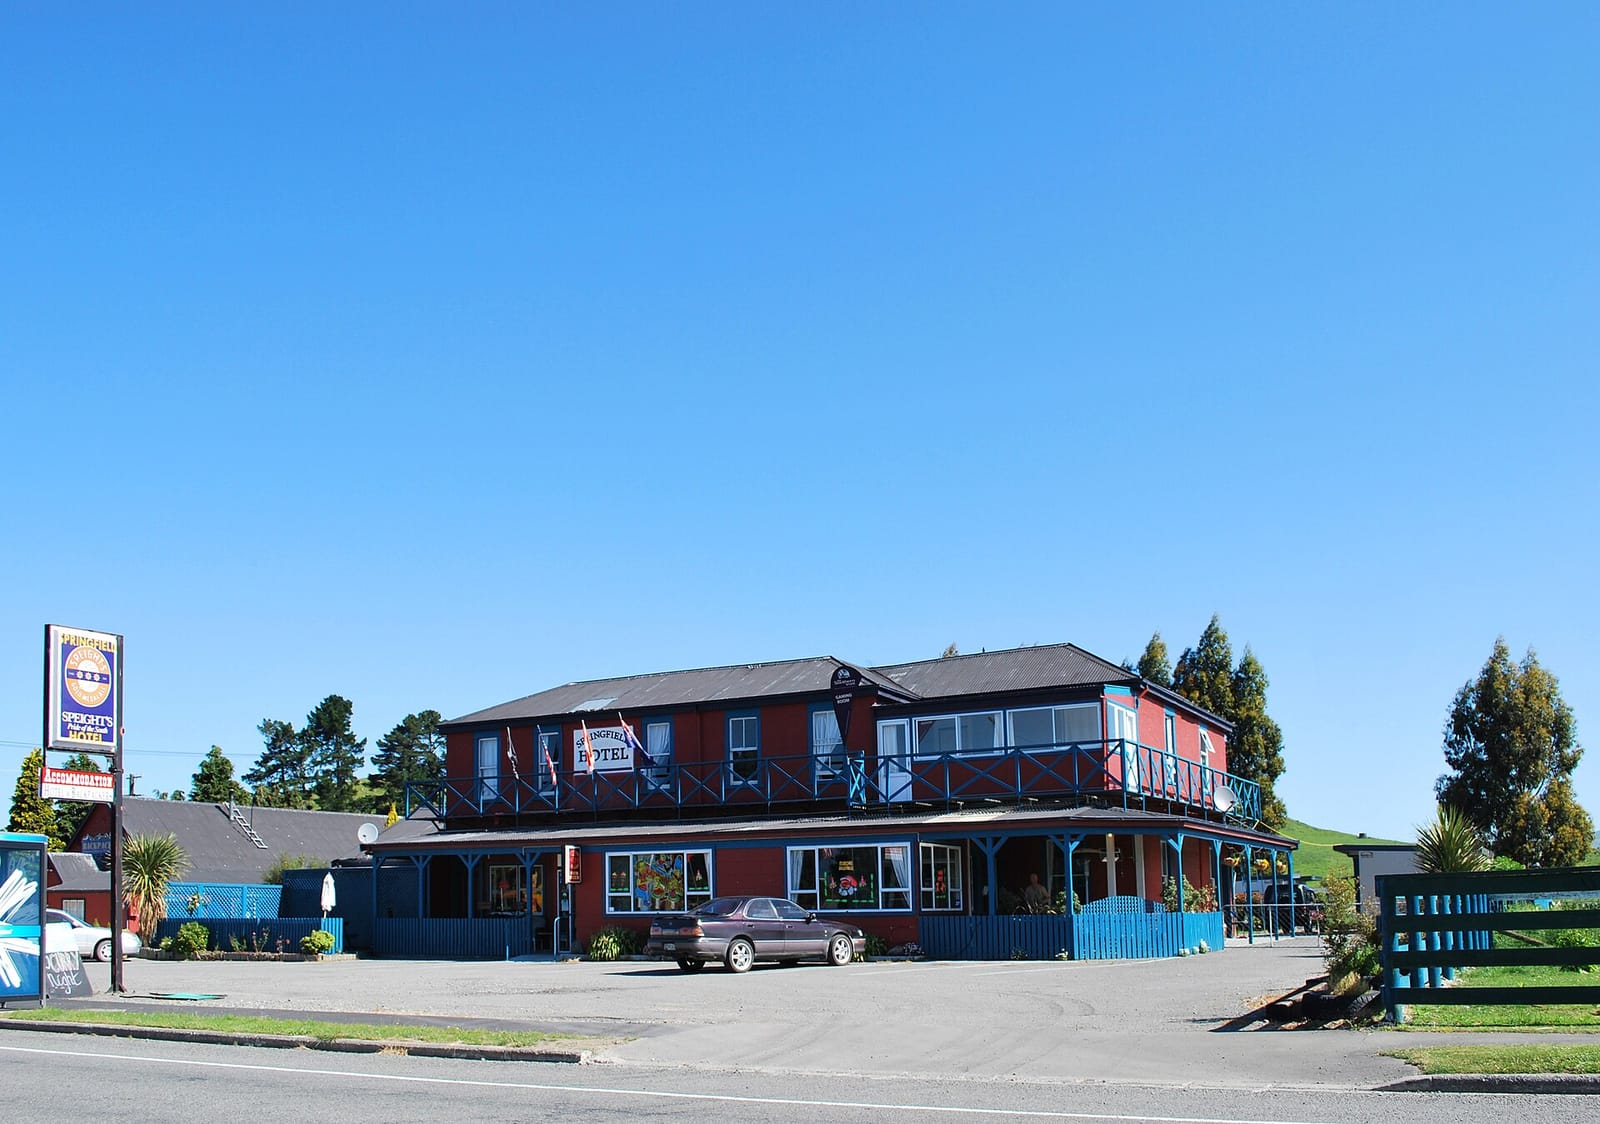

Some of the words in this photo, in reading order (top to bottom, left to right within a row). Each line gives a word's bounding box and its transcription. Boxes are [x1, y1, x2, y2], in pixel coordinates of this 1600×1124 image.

[62, 711, 113, 727] SPEIGHT'S
[69, 731, 103, 743] HOTEL
[578, 748, 629, 763] HOTEL
[44, 769, 113, 787] ACCOMMODATION
